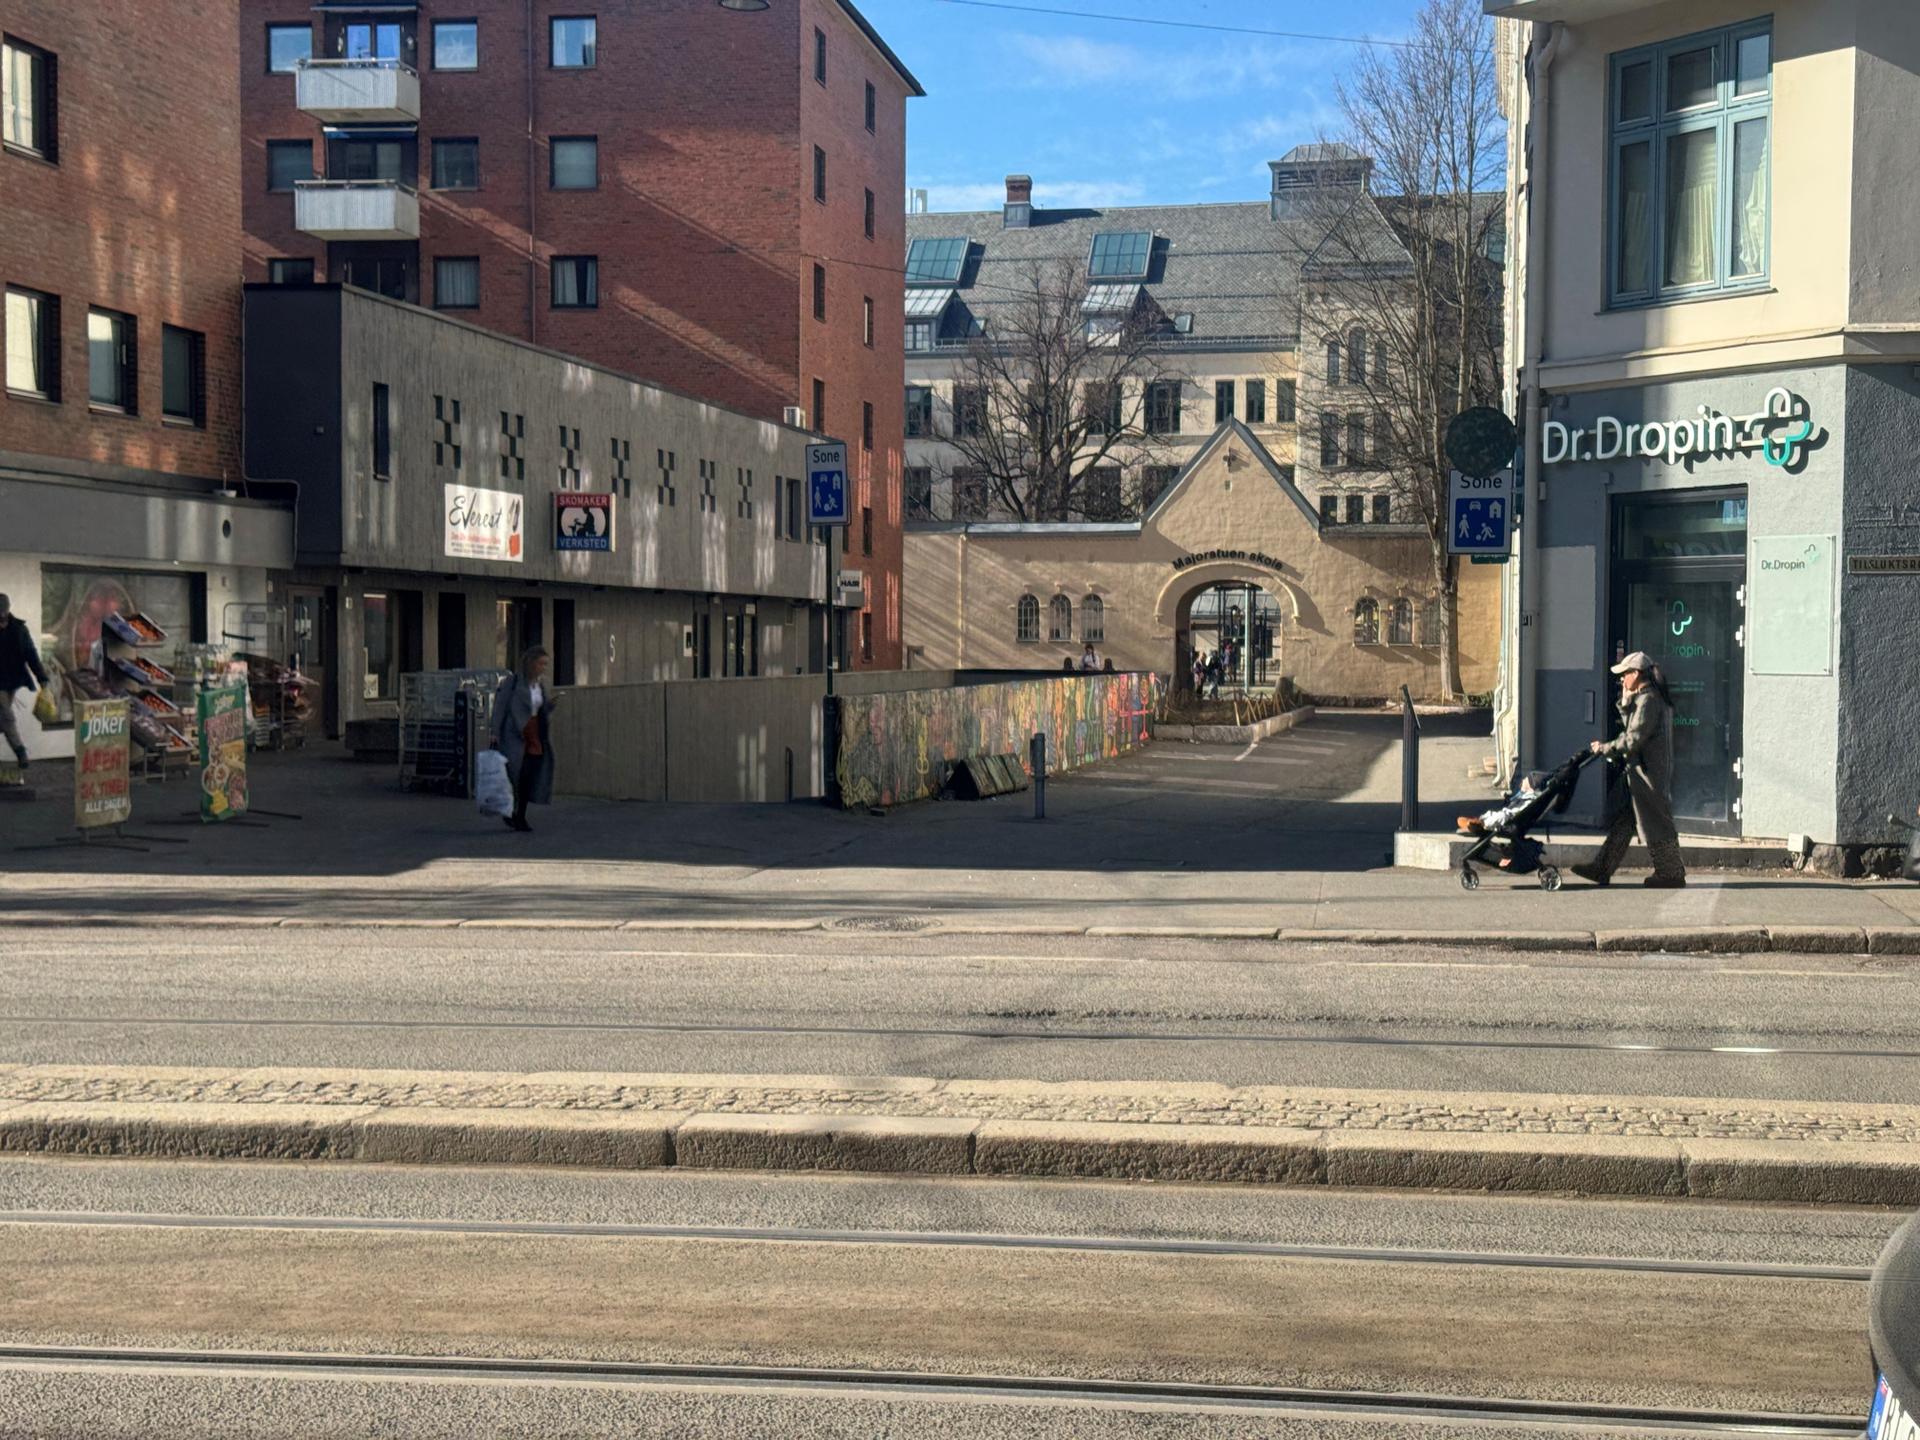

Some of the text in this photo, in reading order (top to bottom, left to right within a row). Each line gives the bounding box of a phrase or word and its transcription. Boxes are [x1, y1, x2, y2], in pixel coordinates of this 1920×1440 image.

[1542, 405, 1734, 465] Dr.Dropin
[812, 449, 840, 463] Sone
[1460, 474, 1503, 489] Sone
[559, 496, 608, 506] SKOMAKER
[448, 492, 503, 530] Everest
[559, 537, 607, 549] VERKSTED
[1172, 549, 1284, 571] Majorstuen skole
[1761, 558, 1806, 572] Dr.Dropin
[84, 799, 103, 813] ALLE
